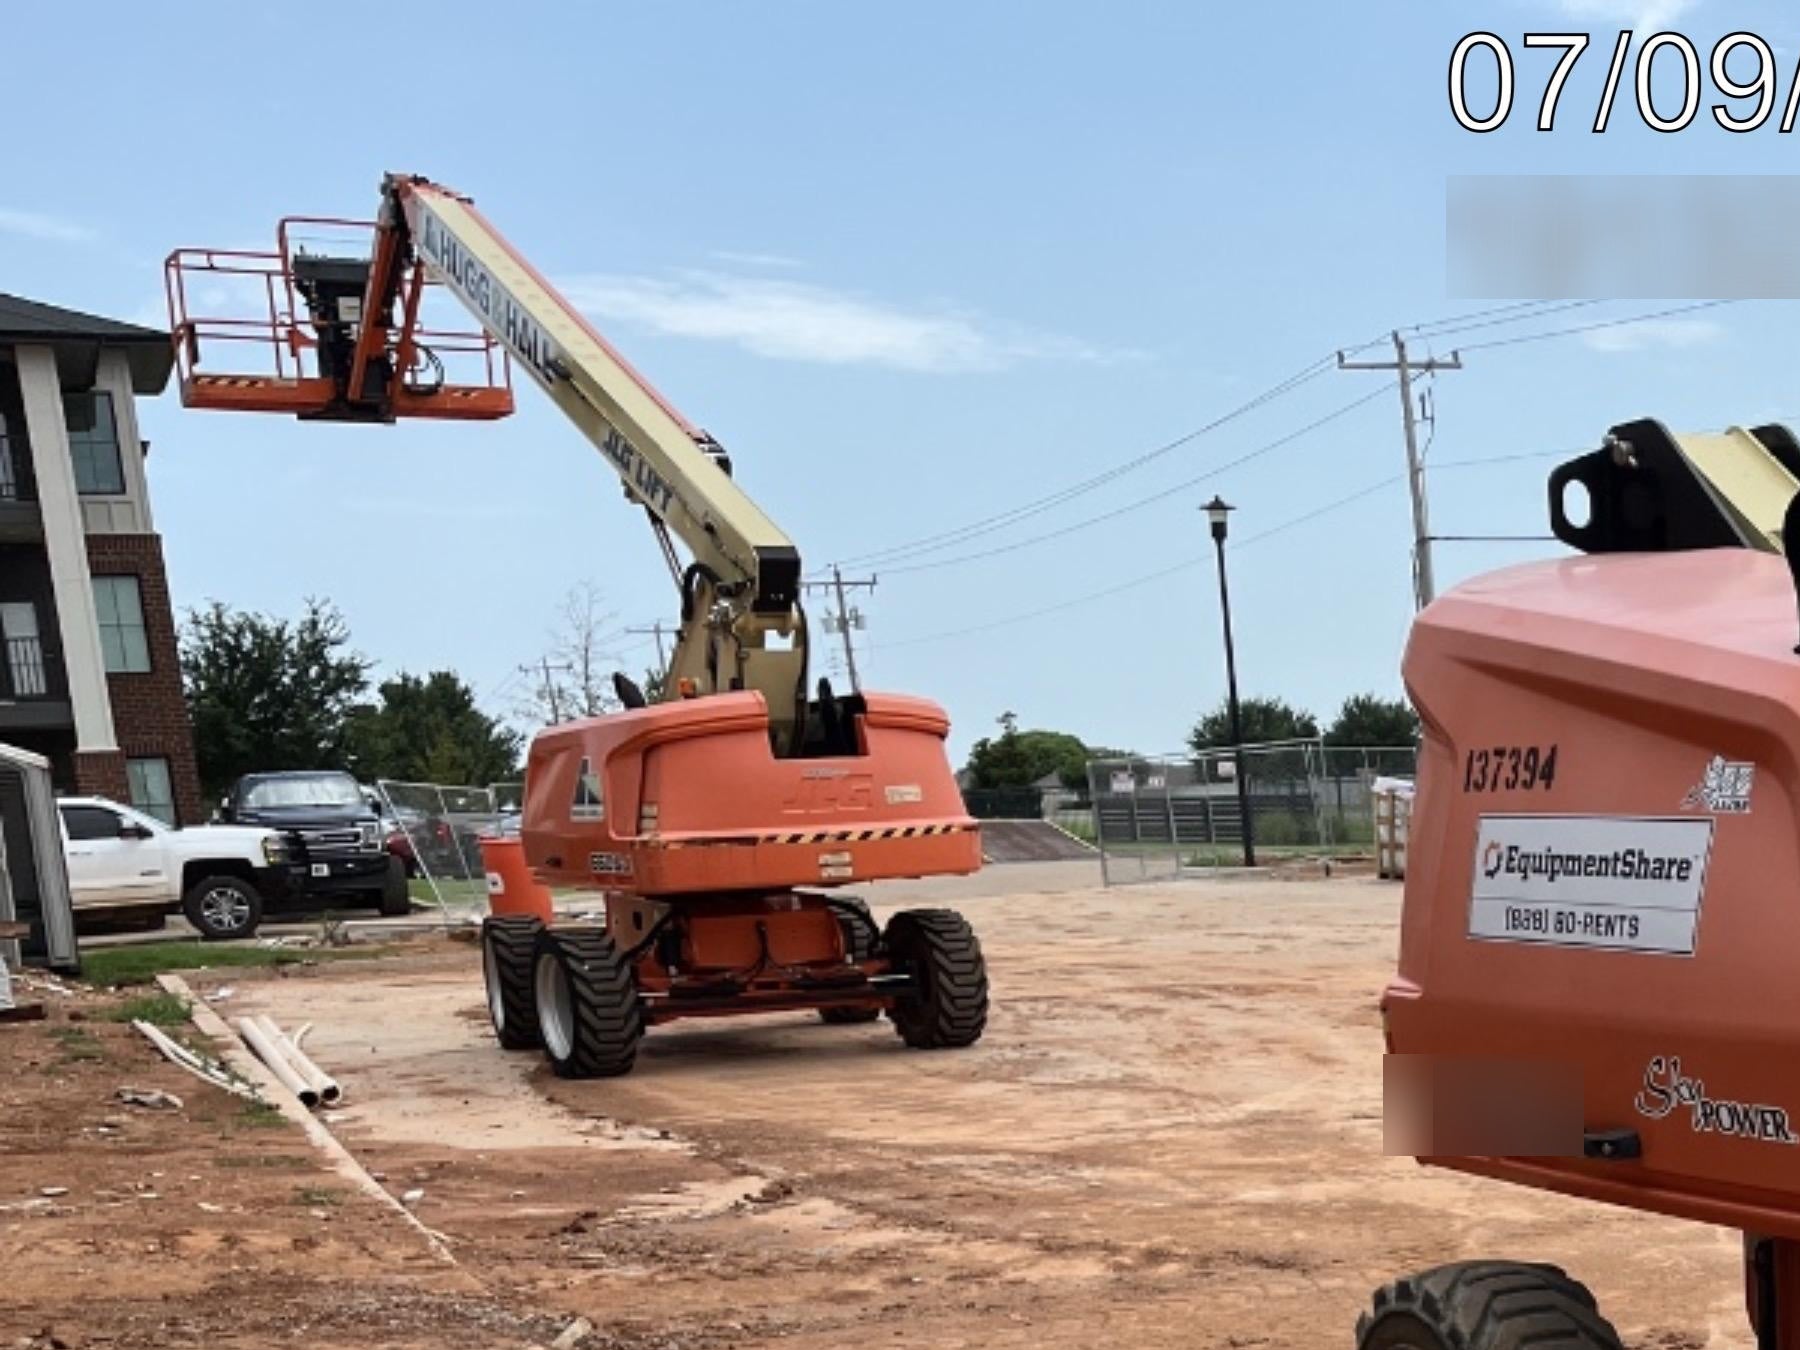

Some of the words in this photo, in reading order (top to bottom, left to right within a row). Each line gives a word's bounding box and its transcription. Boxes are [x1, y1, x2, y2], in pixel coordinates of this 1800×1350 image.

[1463, 744, 1558, 793] 137394
[1504, 846, 1693, 882] EquipmentShare
[1505, 907, 1550, 934] (888)
[1553, 911, 1640, 939] 80-RENTS
[1697, 1099, 1789, 1143] POWER
